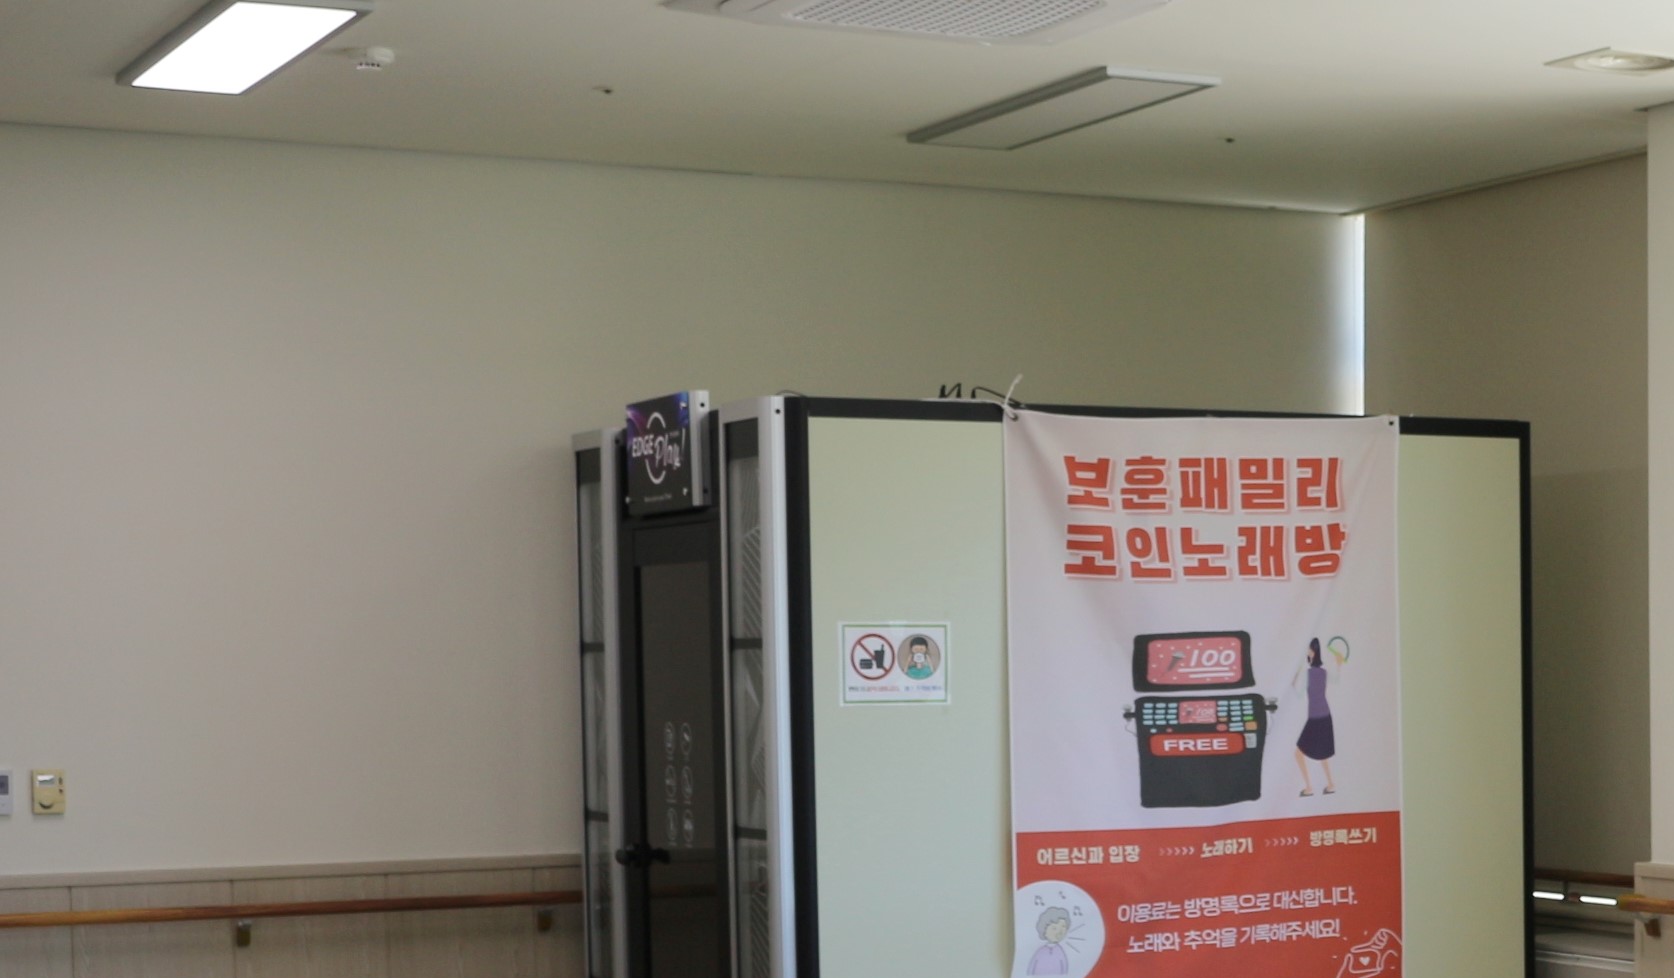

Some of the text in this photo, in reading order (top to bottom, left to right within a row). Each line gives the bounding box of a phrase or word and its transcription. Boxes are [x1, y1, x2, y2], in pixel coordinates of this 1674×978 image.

[632, 434, 655, 458] EDGE
[1063, 454, 1341, 511] 보훈패밀리
[1063, 522, 1347, 579] 코인노래방
[1188, 648, 1236, 668] 100
[1162, 736, 1229, 752] FREE
[1200, 837, 1254, 858] 노래하기
[1309, 827, 1377, 847] 방명록쓰기
[1036, 845, 1140, 865] 어르신과 입장
[1117, 885, 1358, 924] 이용료는 방명록으로 대신합니다.
[1126, 918, 1340, 953] 노래와 추억을 기록해주세요!
